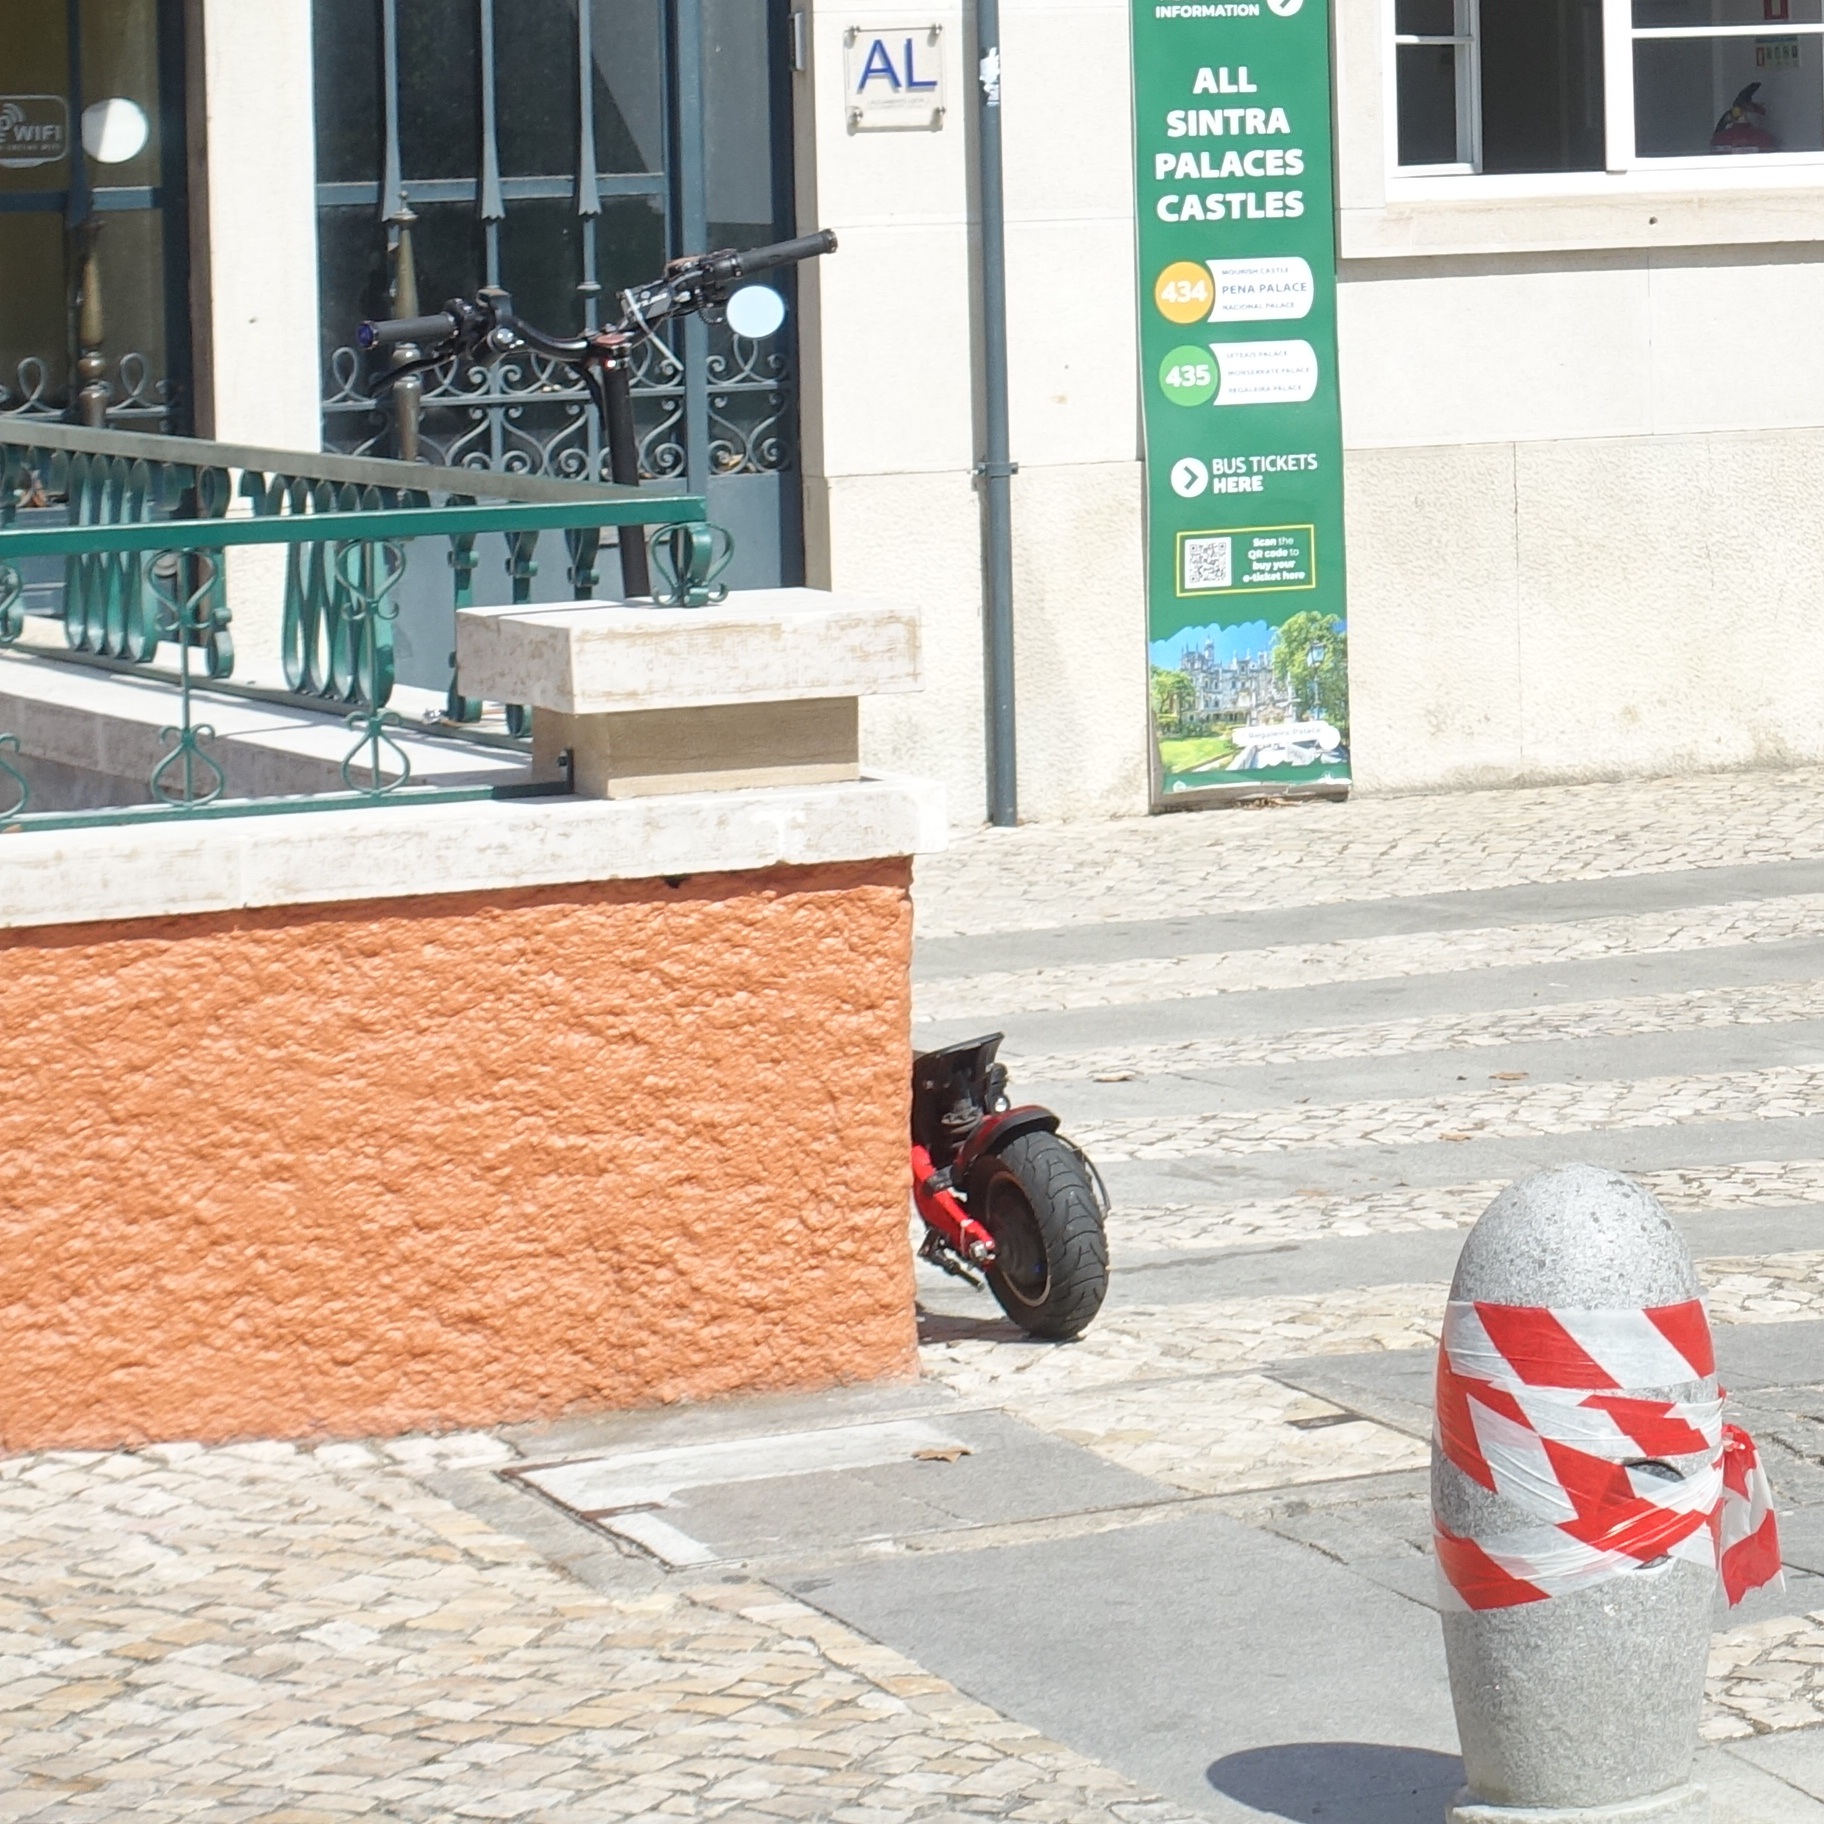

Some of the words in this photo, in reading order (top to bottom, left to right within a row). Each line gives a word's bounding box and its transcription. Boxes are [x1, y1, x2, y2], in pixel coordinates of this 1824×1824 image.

[1155, 3, 1260, 19] INFORMATION
[857, 38, 938, 90] AL
[1193, 66, 1257, 94] ALL
[1166, 107, 1291, 138] SINTRA
[13, 125, 60, 141] WIFI
[1155, 148, 1305, 180] PALACES
[1156, 190, 1305, 222] CASTLES
[1161, 280, 1208, 303] 434
[1222, 285, 1255, 294] PENA
[1259, 282, 1307, 293] PALACE
[1165, 364, 1211, 387] 435
[1213, 456, 1246, 475] BUS
[1249, 453, 1318, 473] TICKETS
[1213, 475, 1264, 494] HERE
[1253, 537, 1277, 547] Scan
[1278, 536, 1294, 545] the
[1247, 549, 1263, 560] QR
[1264, 548, 1288, 558] code
[1289, 548, 1300, 556] to
[1252, 561, 1272, 571] buy
[1273, 560, 1296, 571] your
[1242, 572, 1281, 583] e-ticket
[1282, 571, 1306, 580] here
